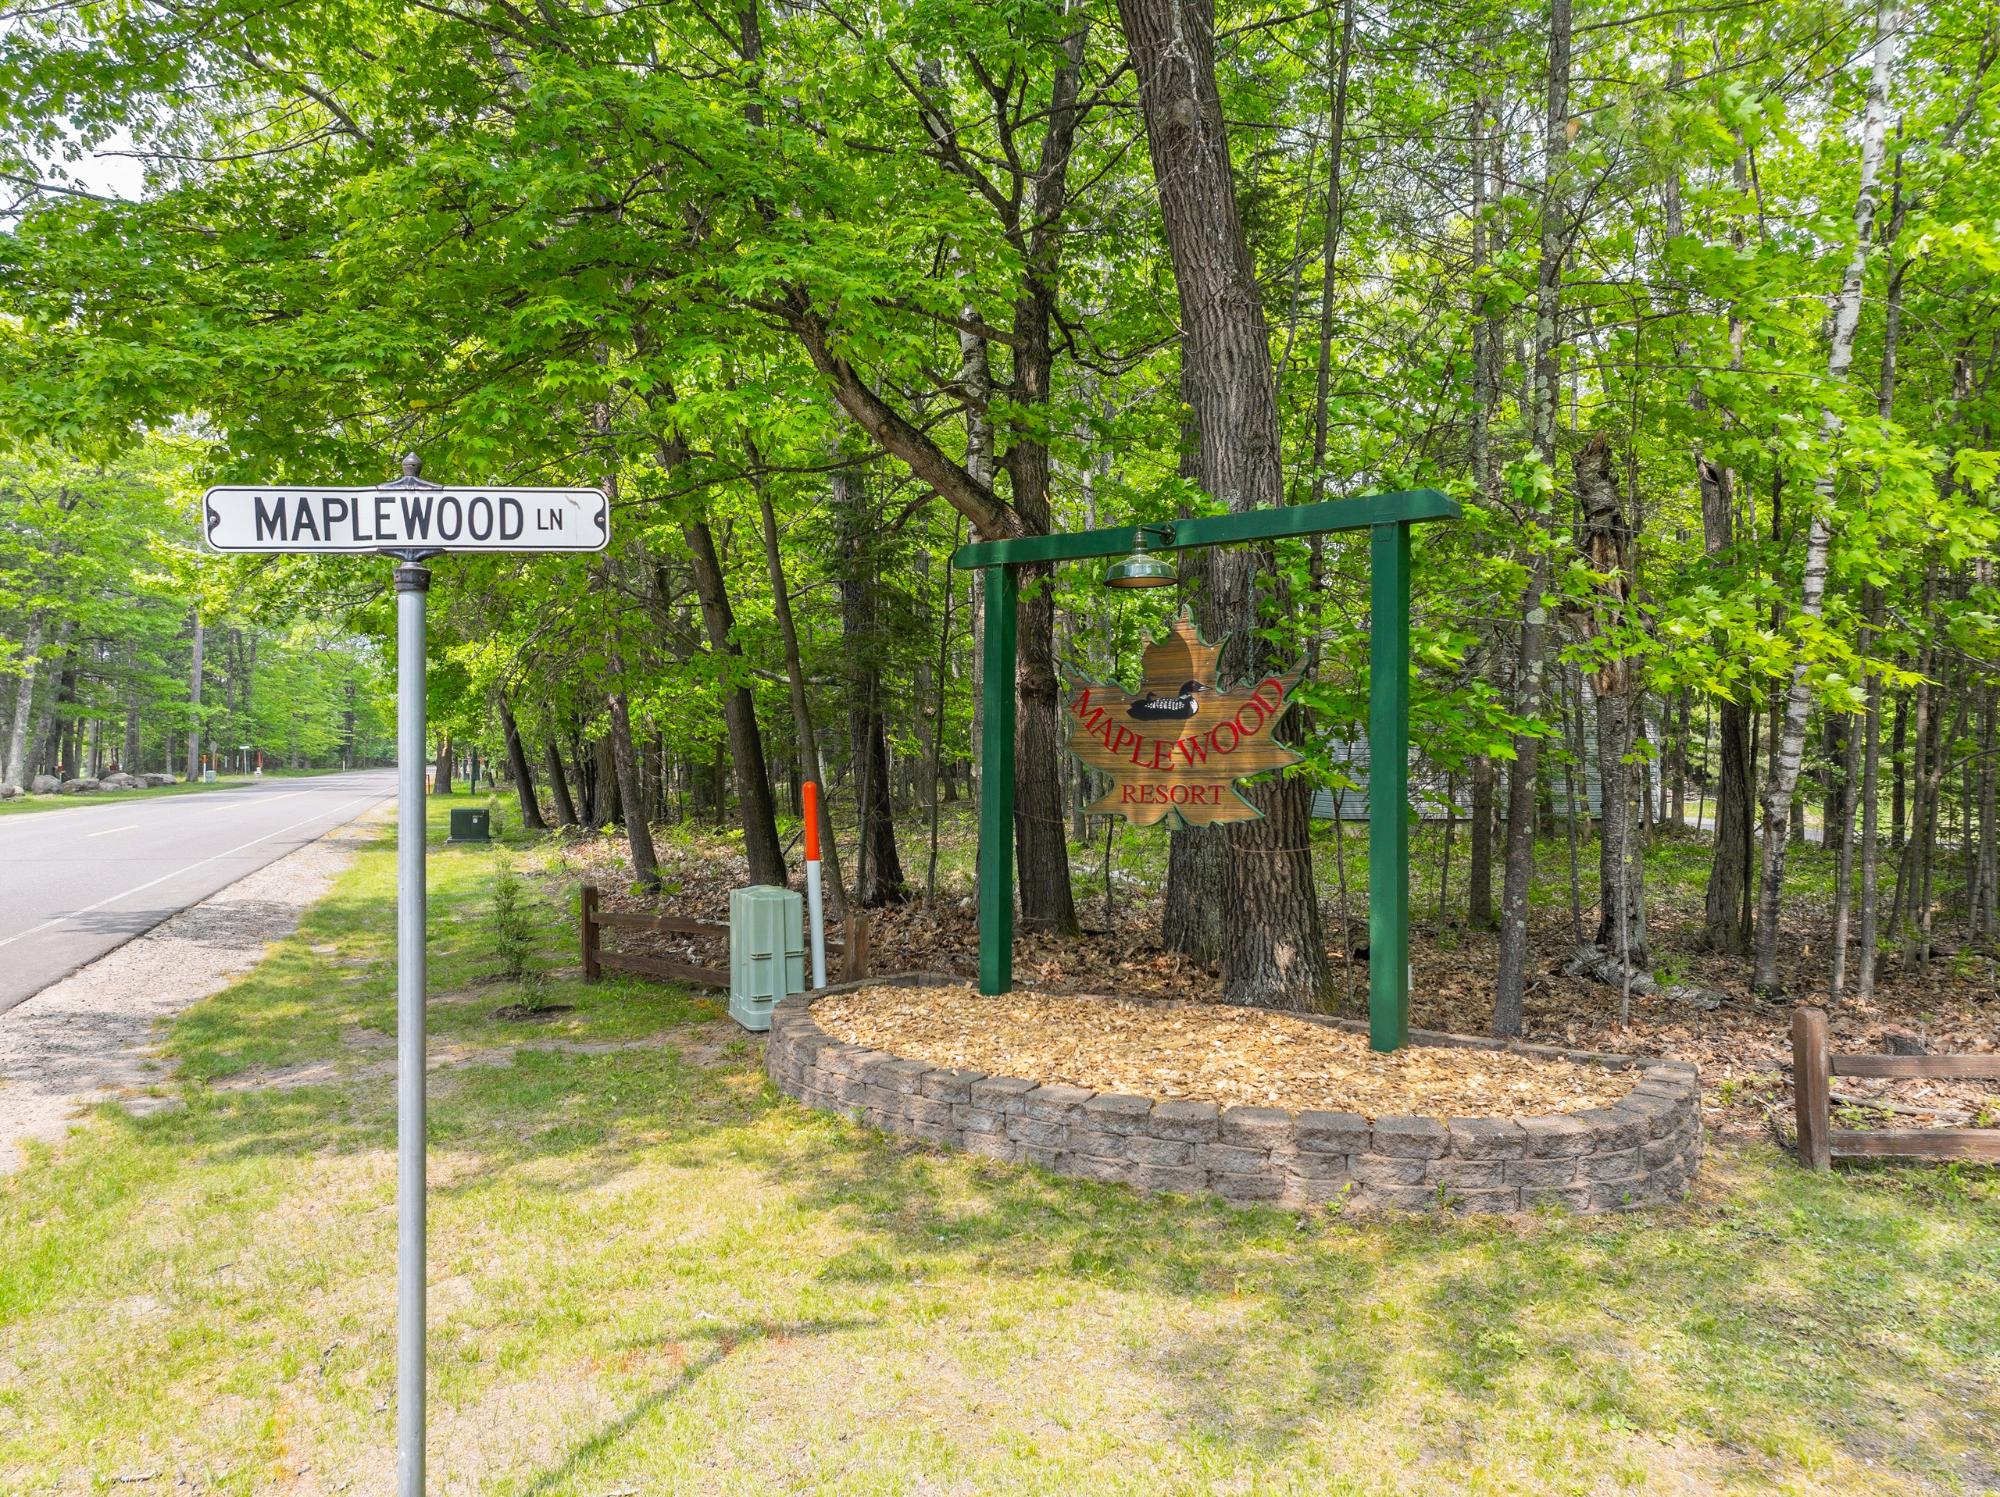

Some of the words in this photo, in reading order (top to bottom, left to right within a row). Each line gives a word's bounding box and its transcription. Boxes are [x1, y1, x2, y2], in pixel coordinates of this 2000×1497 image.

[254, 497, 524, 541] MAPLEWOOD
[537, 509, 562, 530] LN
[1071, 679, 1284, 771] MAPLEWOOD
[1122, 784, 1226, 805] RESORT
